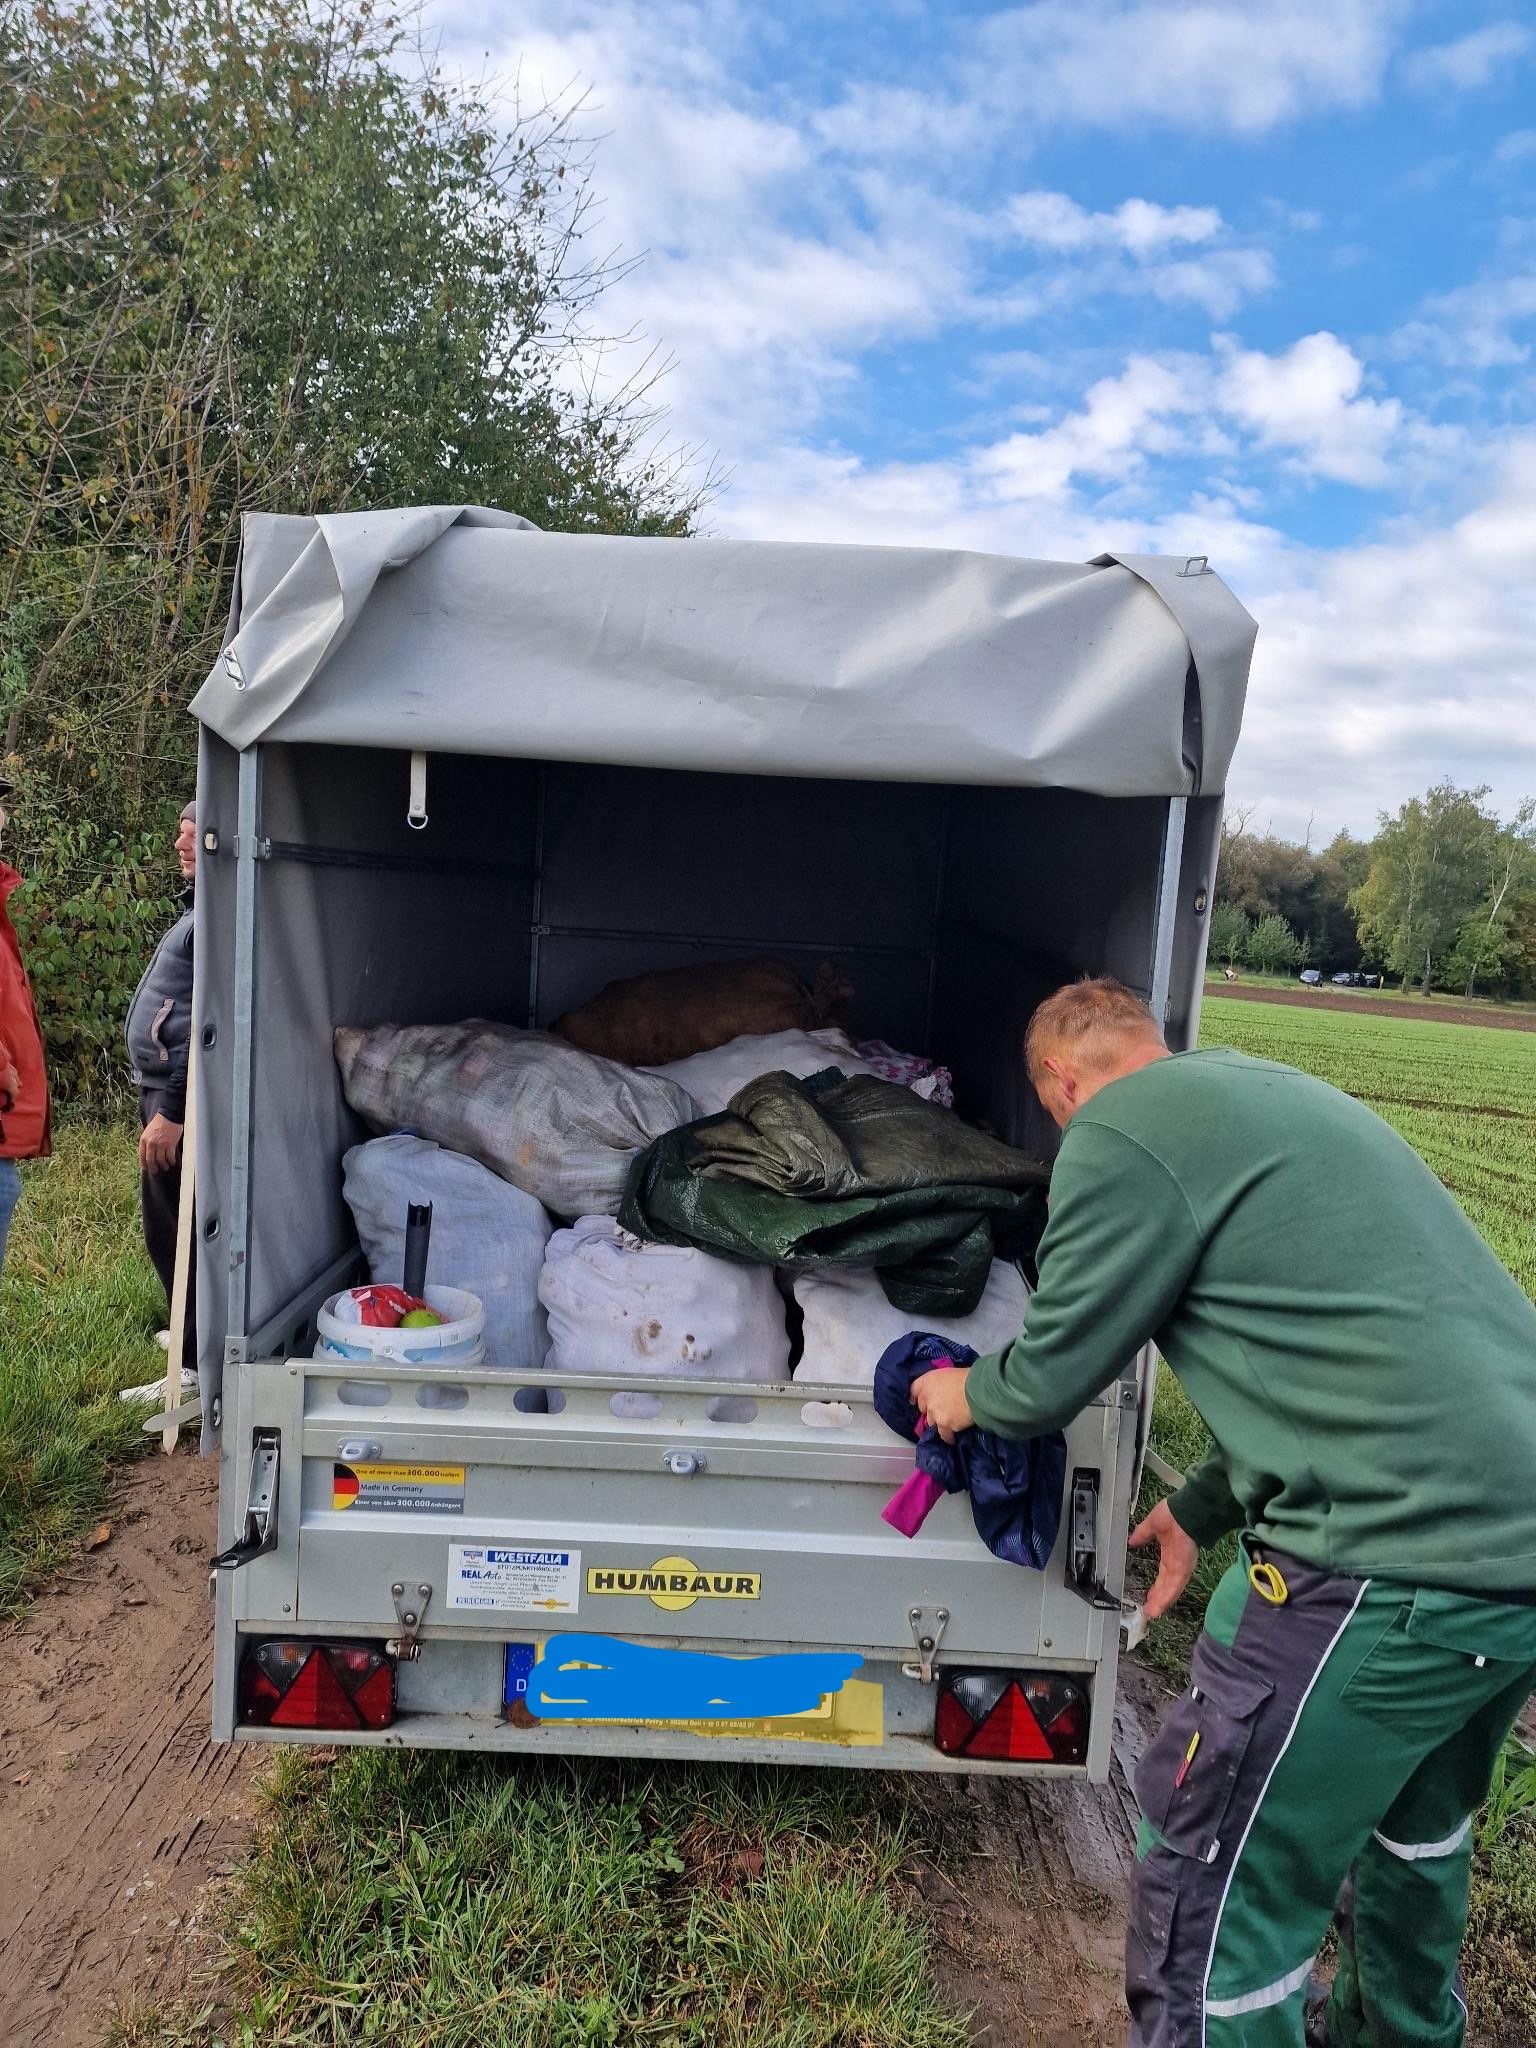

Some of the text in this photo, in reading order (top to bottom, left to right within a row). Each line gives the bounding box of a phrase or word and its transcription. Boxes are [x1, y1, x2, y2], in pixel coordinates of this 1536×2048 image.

[407, 1469, 440, 1477] 300.000
[391, 1484, 423, 1493] Germany
[397, 1499, 430, 1507] 300.000
[494, 1551, 562, 1564] WESTFALIA
[461, 1569, 482, 1580] REAL
[594, 1572, 754, 1594] HUMBAUR
[515, 1679, 527, 1692] D
